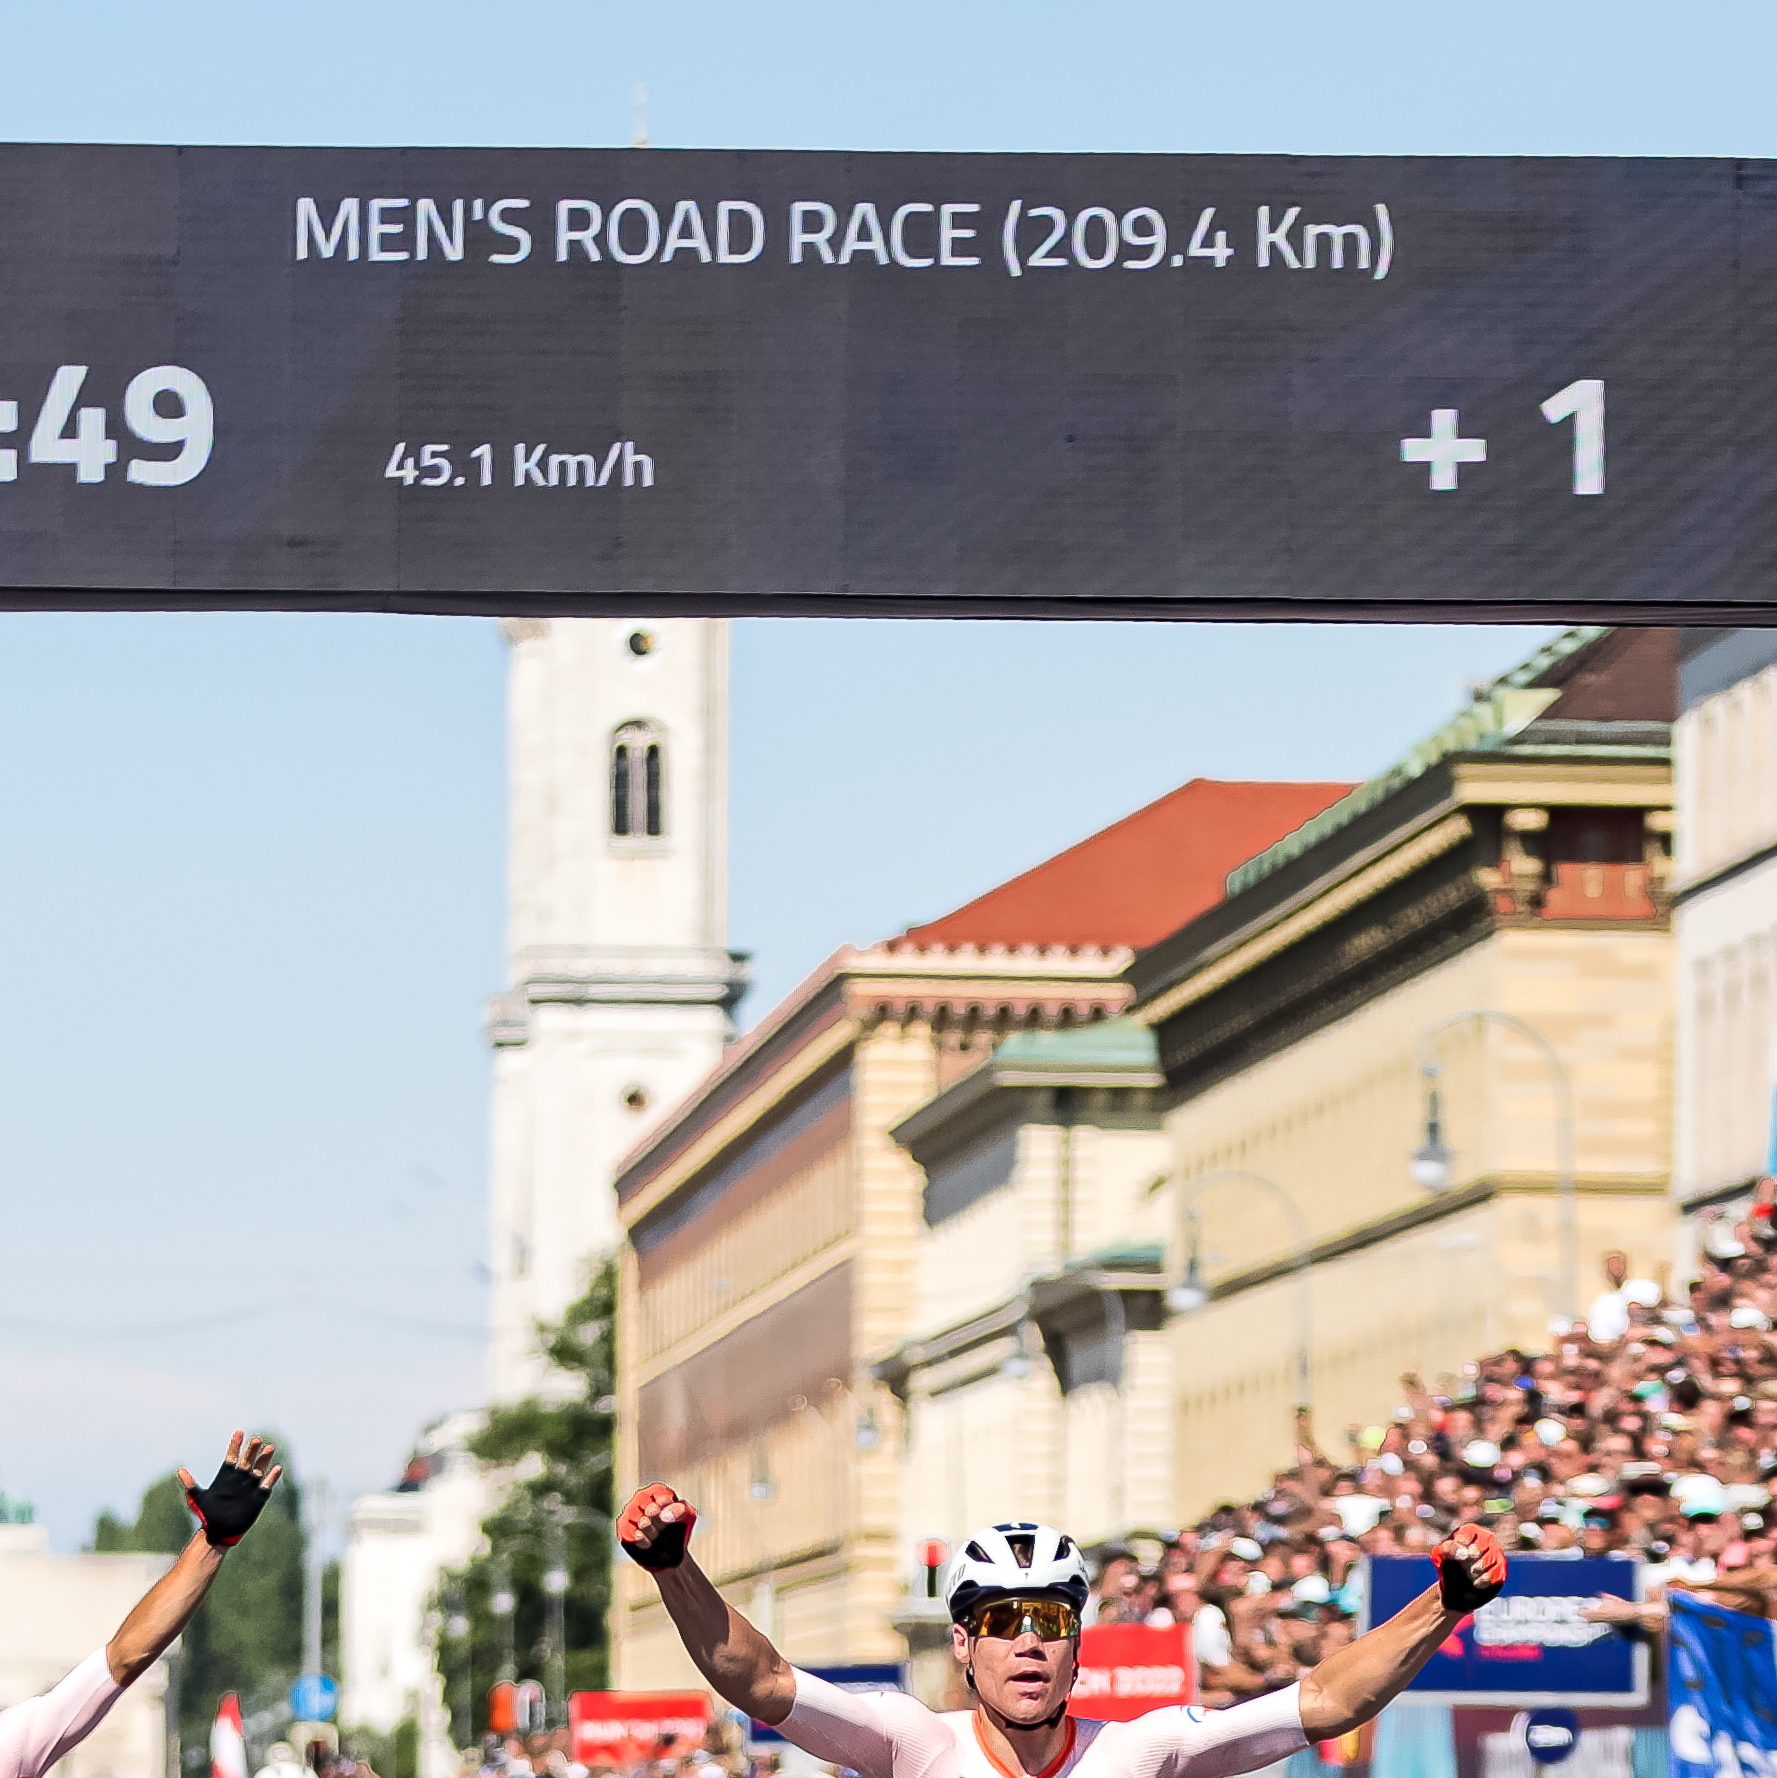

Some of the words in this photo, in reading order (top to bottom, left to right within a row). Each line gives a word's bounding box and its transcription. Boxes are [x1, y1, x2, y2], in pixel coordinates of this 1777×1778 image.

[295, 196, 533, 264] MEN'S
[556, 198, 765, 266] ROAD
[789, 200, 982, 267] RACE
[1001, 200, 1234, 278] (209.4
[1256, 203, 1394, 281] Km)
[384, 442, 494, 488] 45.1
[512, 441, 655, 489] Km/h
[1538, 379, 1606, 495] 1
